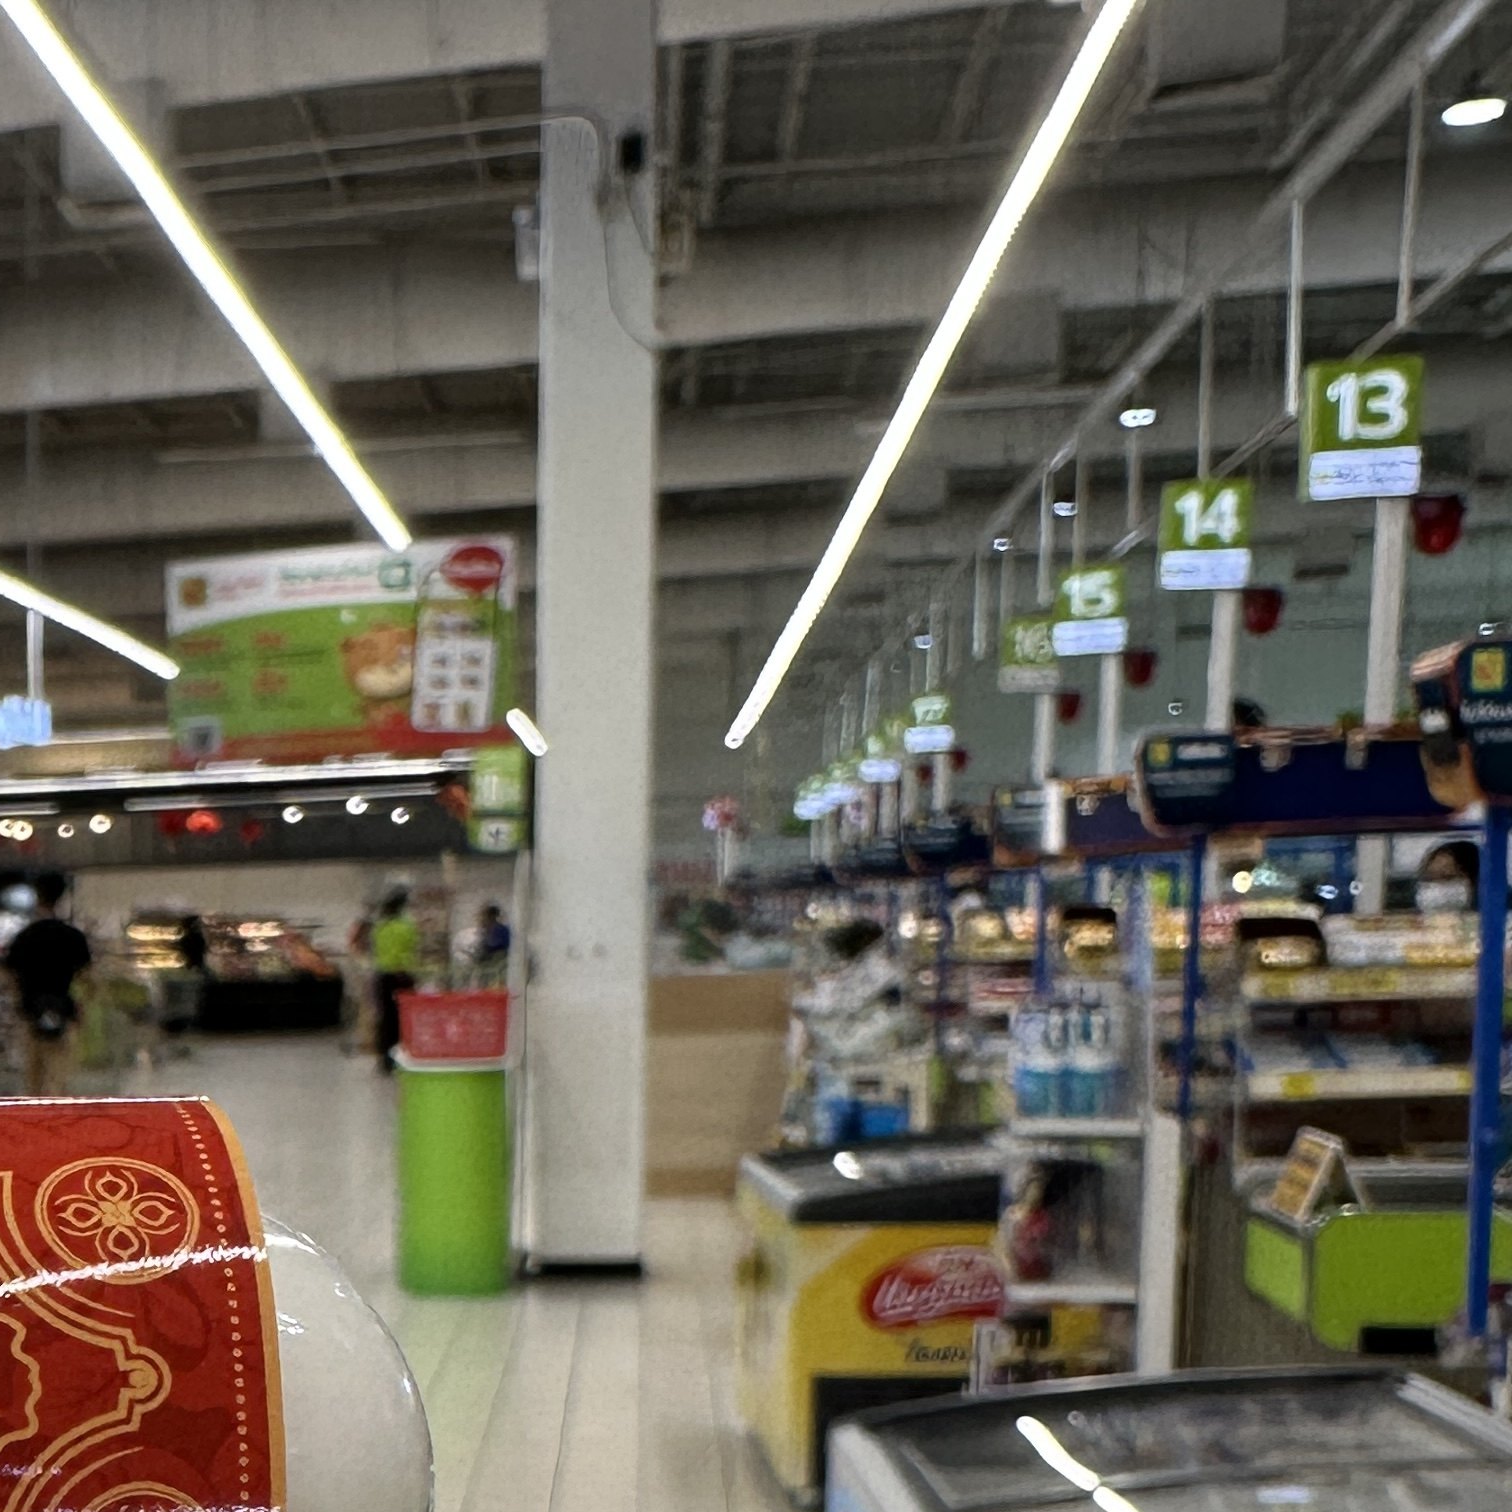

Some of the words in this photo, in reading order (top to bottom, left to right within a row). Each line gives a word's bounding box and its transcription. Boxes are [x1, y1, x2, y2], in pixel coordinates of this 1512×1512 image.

[1326, 368, 1410, 441] 13
[1174, 487, 1240, 547] 14
[1060, 571, 1119, 619] 15
